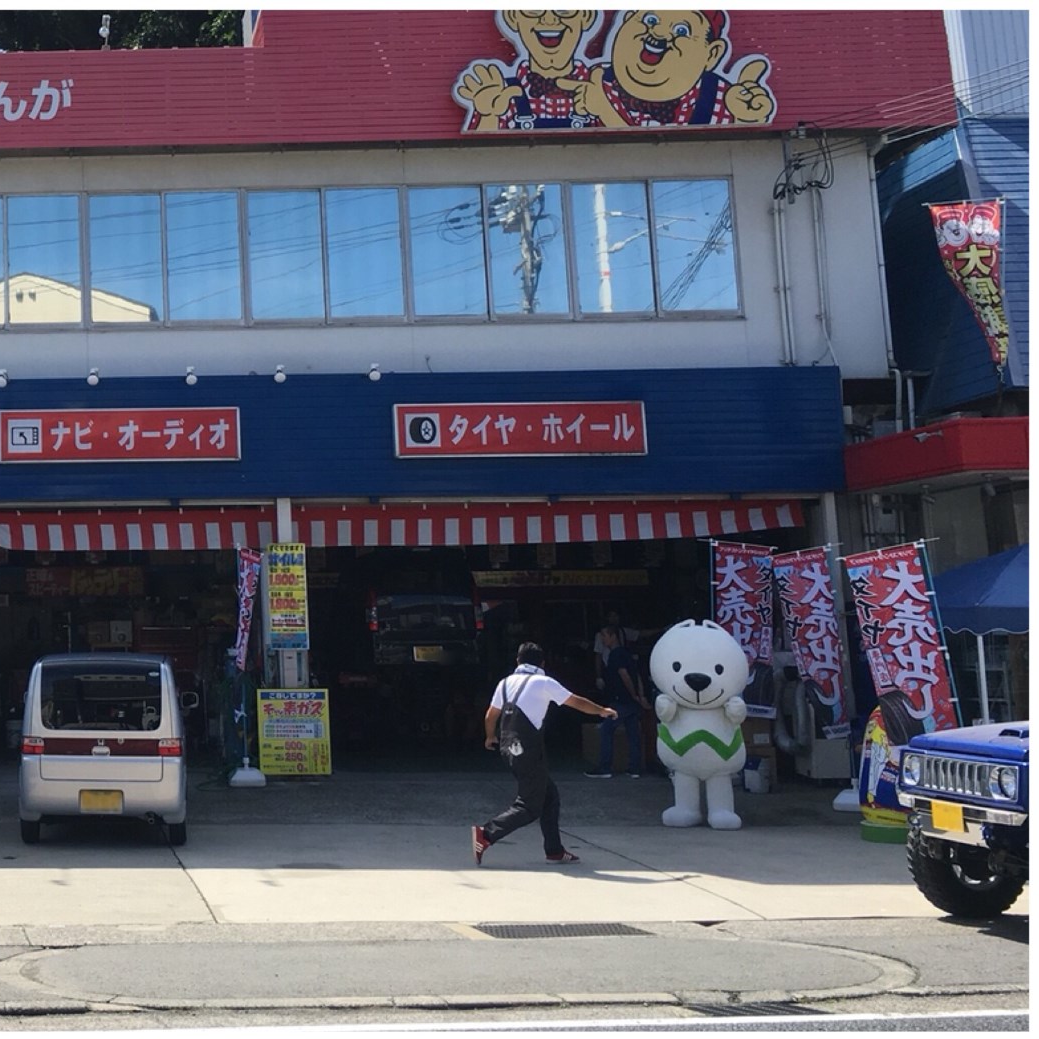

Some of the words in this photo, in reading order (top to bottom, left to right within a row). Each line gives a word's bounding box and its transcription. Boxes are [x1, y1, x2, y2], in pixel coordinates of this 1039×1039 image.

[51, 419, 230, 451] ナビ・オーディオ
[449, 413, 635, 446] タイヤ・ホイール
[755, 565, 773, 624] タイヤ
[716, 555, 758, 684] 大売出
